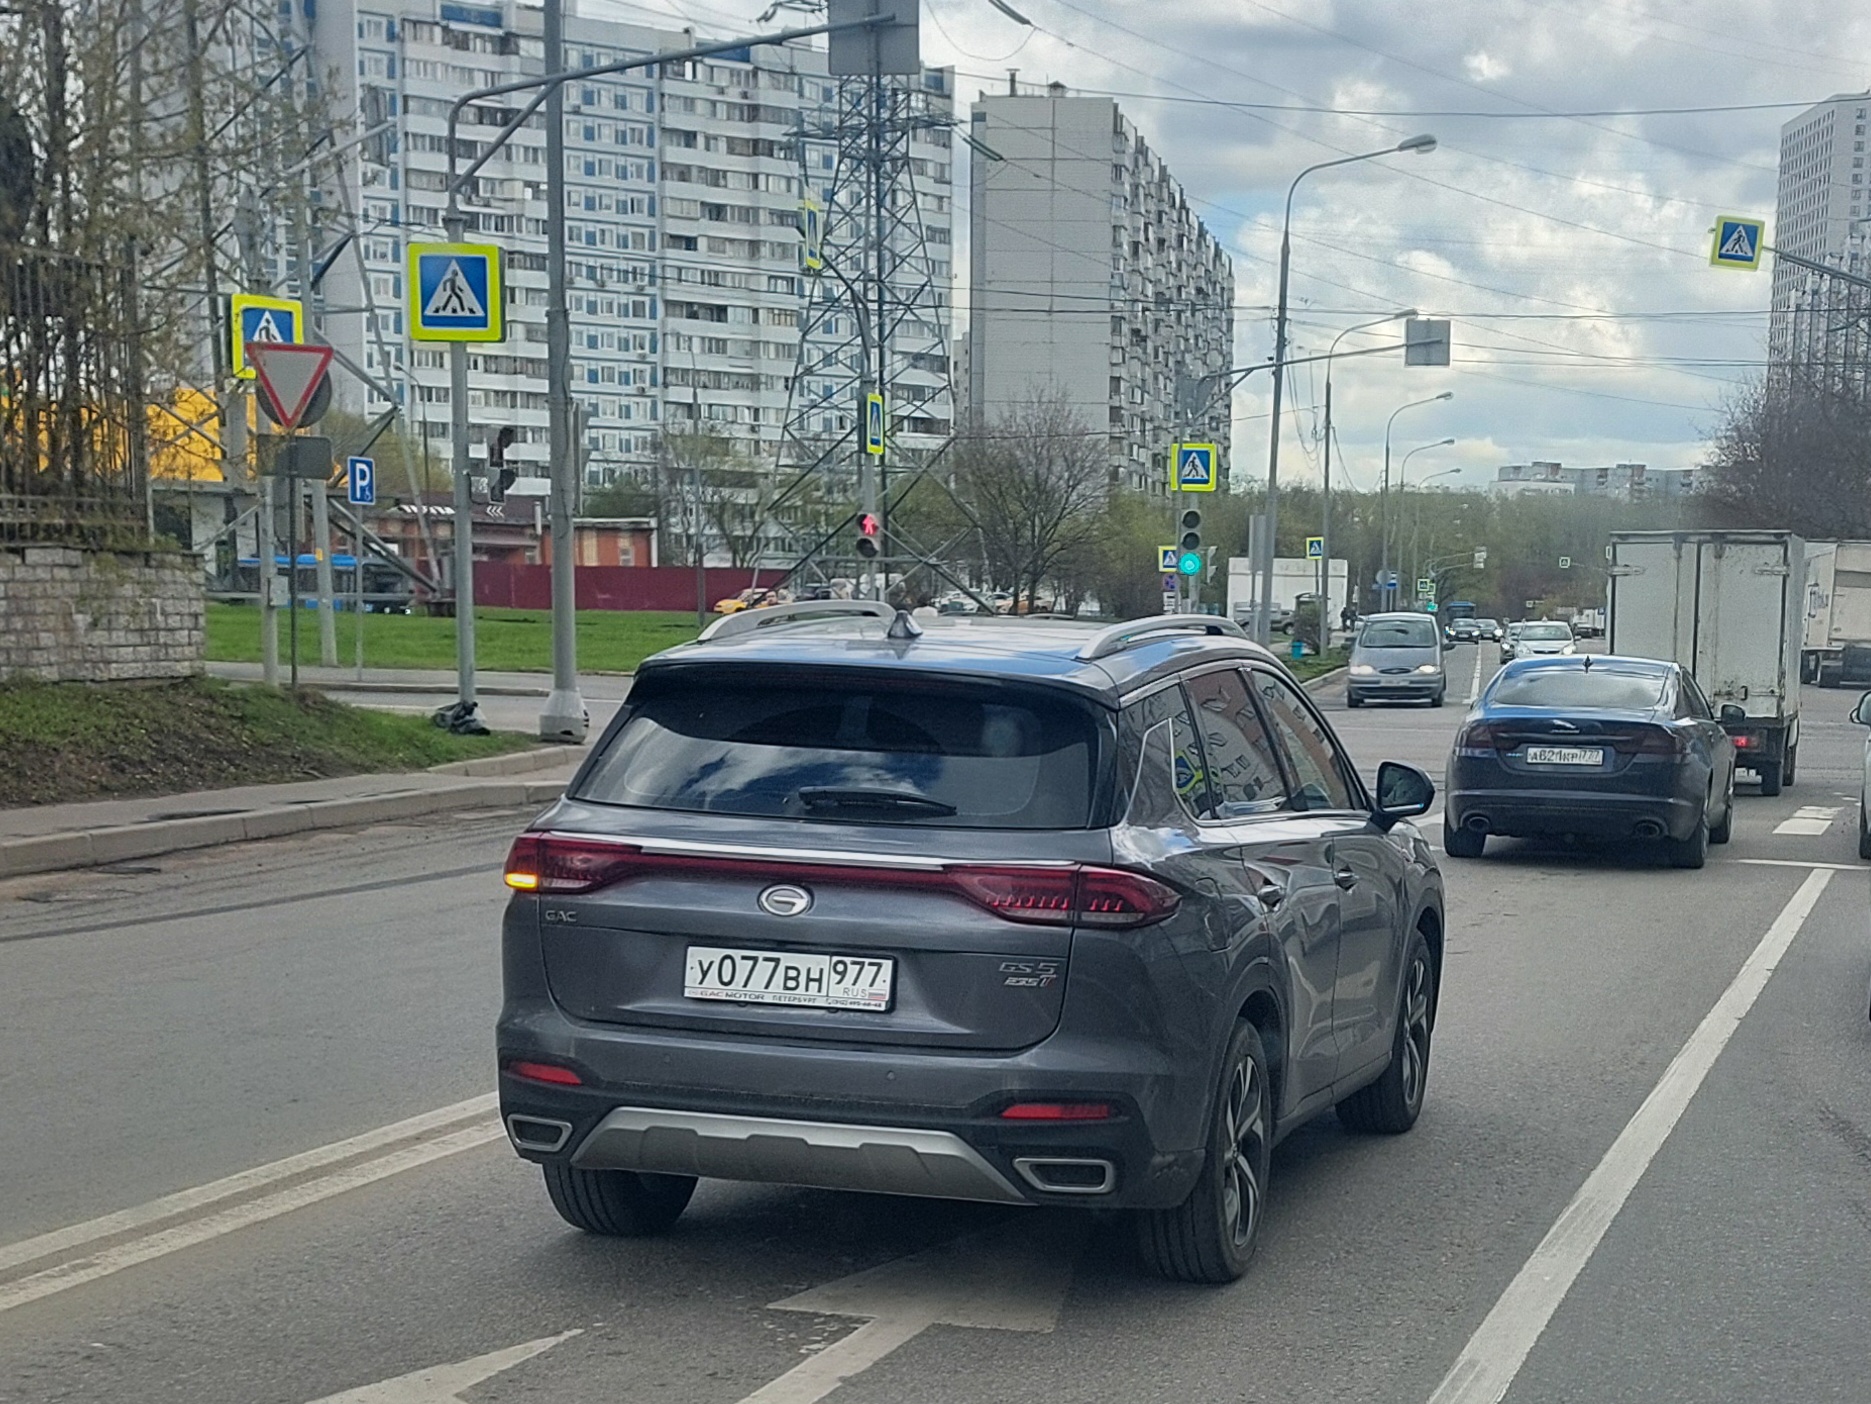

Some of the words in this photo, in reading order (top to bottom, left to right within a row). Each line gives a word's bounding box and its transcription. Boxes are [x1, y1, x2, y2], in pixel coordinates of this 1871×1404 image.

[355, 462, 370, 500] P
[545, 910, 577, 922] GAC
[697, 954, 824, 993] У077ВН
[832, 960, 883, 987] 977
[725, 991, 765, 1001] MOTOR
[842, 987, 868, 998] RUS
